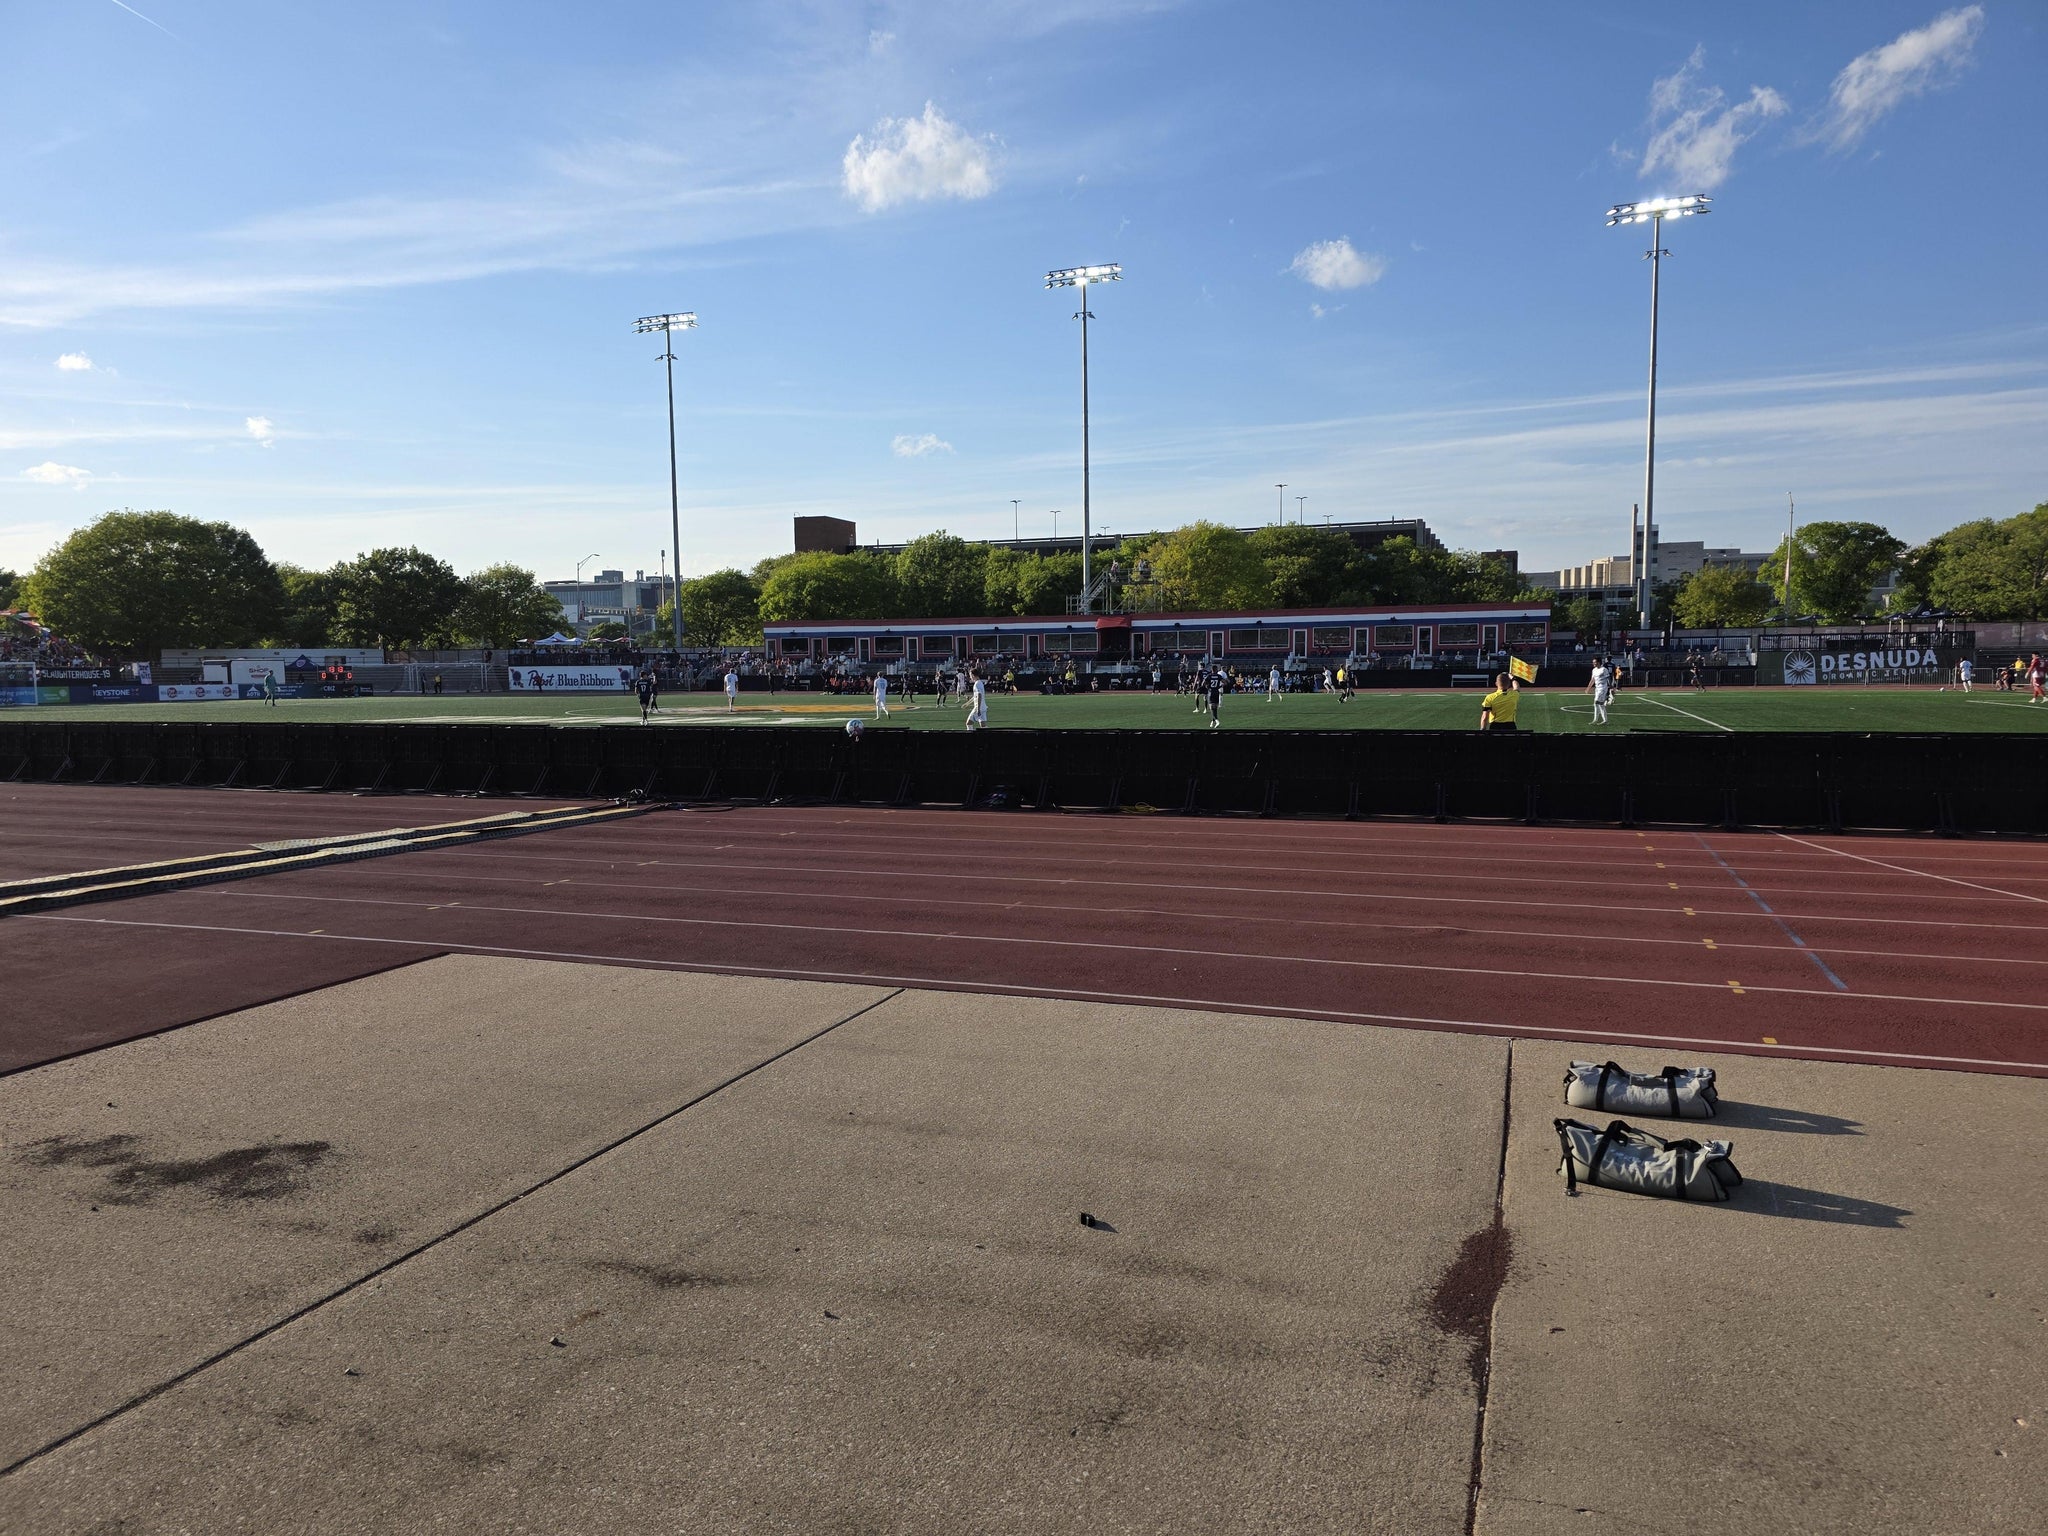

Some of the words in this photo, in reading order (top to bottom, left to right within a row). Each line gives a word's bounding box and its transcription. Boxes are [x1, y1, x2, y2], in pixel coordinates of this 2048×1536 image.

[1820, 649, 1938, 673] DESNUDA
[557, 674, 579, 687] Blue
[579, 673, 614, 687] Ribbon
[1822, 671, 1877, 681] ORGANC
[1210, 679, 1219, 688] 27
